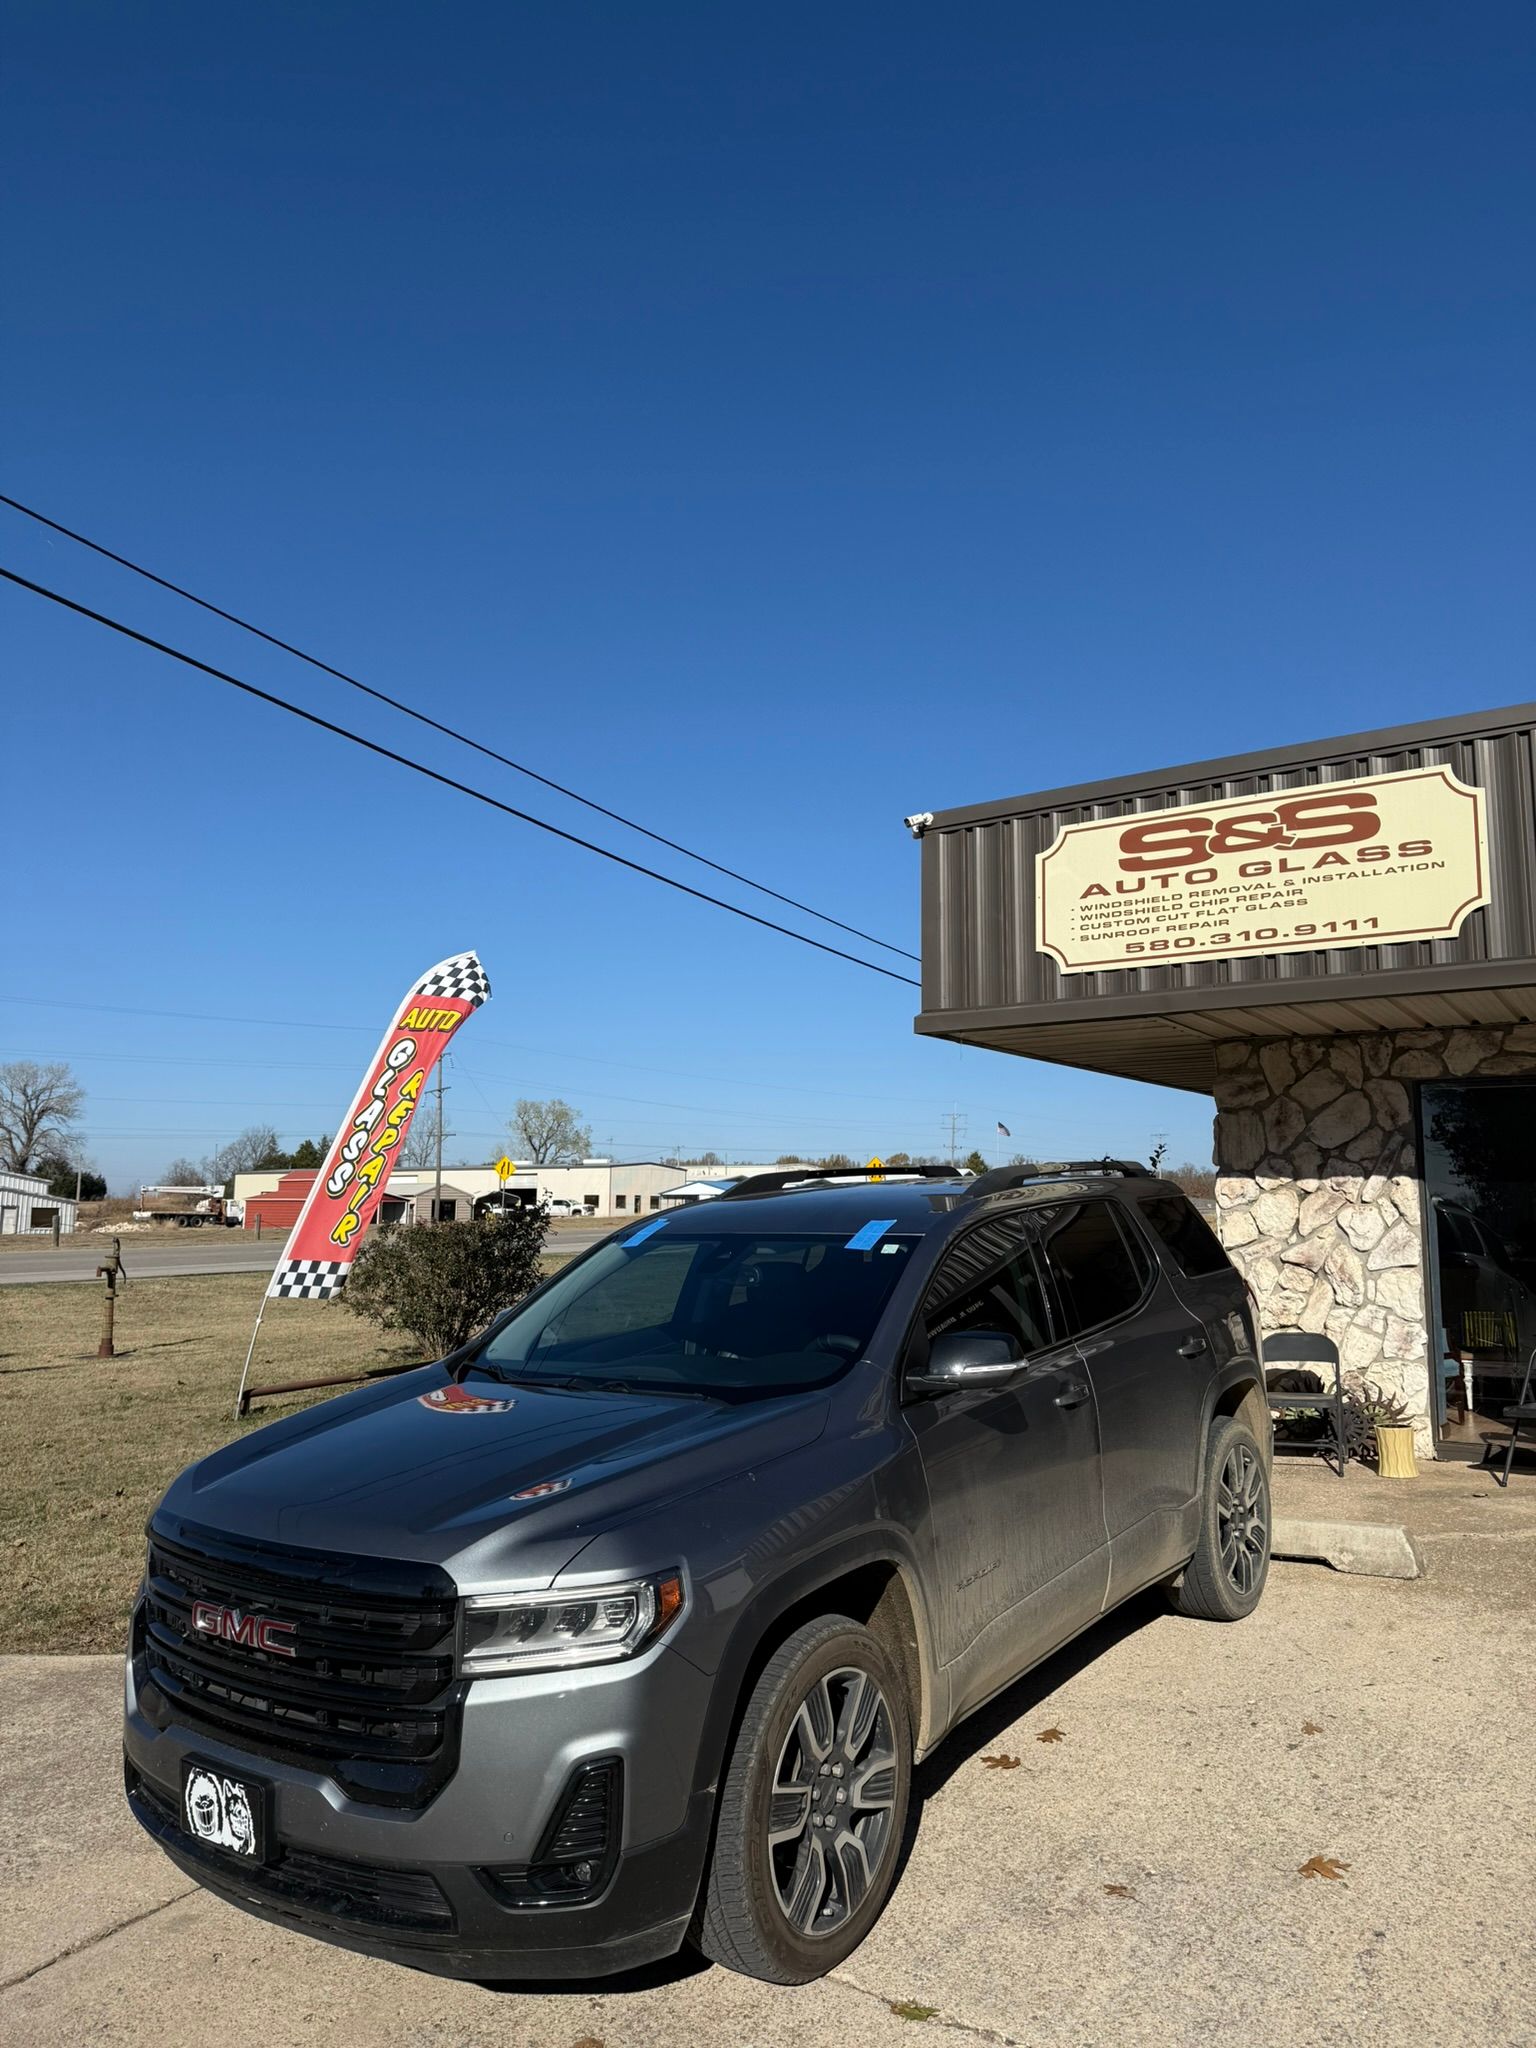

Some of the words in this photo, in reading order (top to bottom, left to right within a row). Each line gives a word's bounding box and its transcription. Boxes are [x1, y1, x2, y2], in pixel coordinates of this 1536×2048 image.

[1118, 792, 1381, 872] S&S
[1079, 867, 1218, 899] AUTO
[1238, 840, 1433, 878] GLASS
[1080, 893, 1183, 912] WINDSHIELD
[1189, 881, 1276, 898] REMOVAL
[1283, 879, 1295, 887] &
[1302, 861, 1445, 885] INSTALLATION
[1079, 916, 1151, 931] CUSTOM
[1156, 911, 1190, 922] CUT
[1196, 906, 1239, 917] FLAT
[1245, 898, 1308, 912] GLASS
[1079, 926, 1161, 942] SUNROOF
[1165, 918, 1230, 932] REPAIR
[1080, 903, 1183, 922] WINDSHIELD
[1189, 898, 1230, 908] CHIP
[1236, 888, 1303, 903] REPAIR
[1125, 917, 1379, 954] 580.310.9111
[398, 1007, 464, 1032] AUTO
[326, 1037, 416, 1198] GLASS
[331, 1069, 425, 1246] REPAIR
[192, 1600, 297, 1657] GMC
